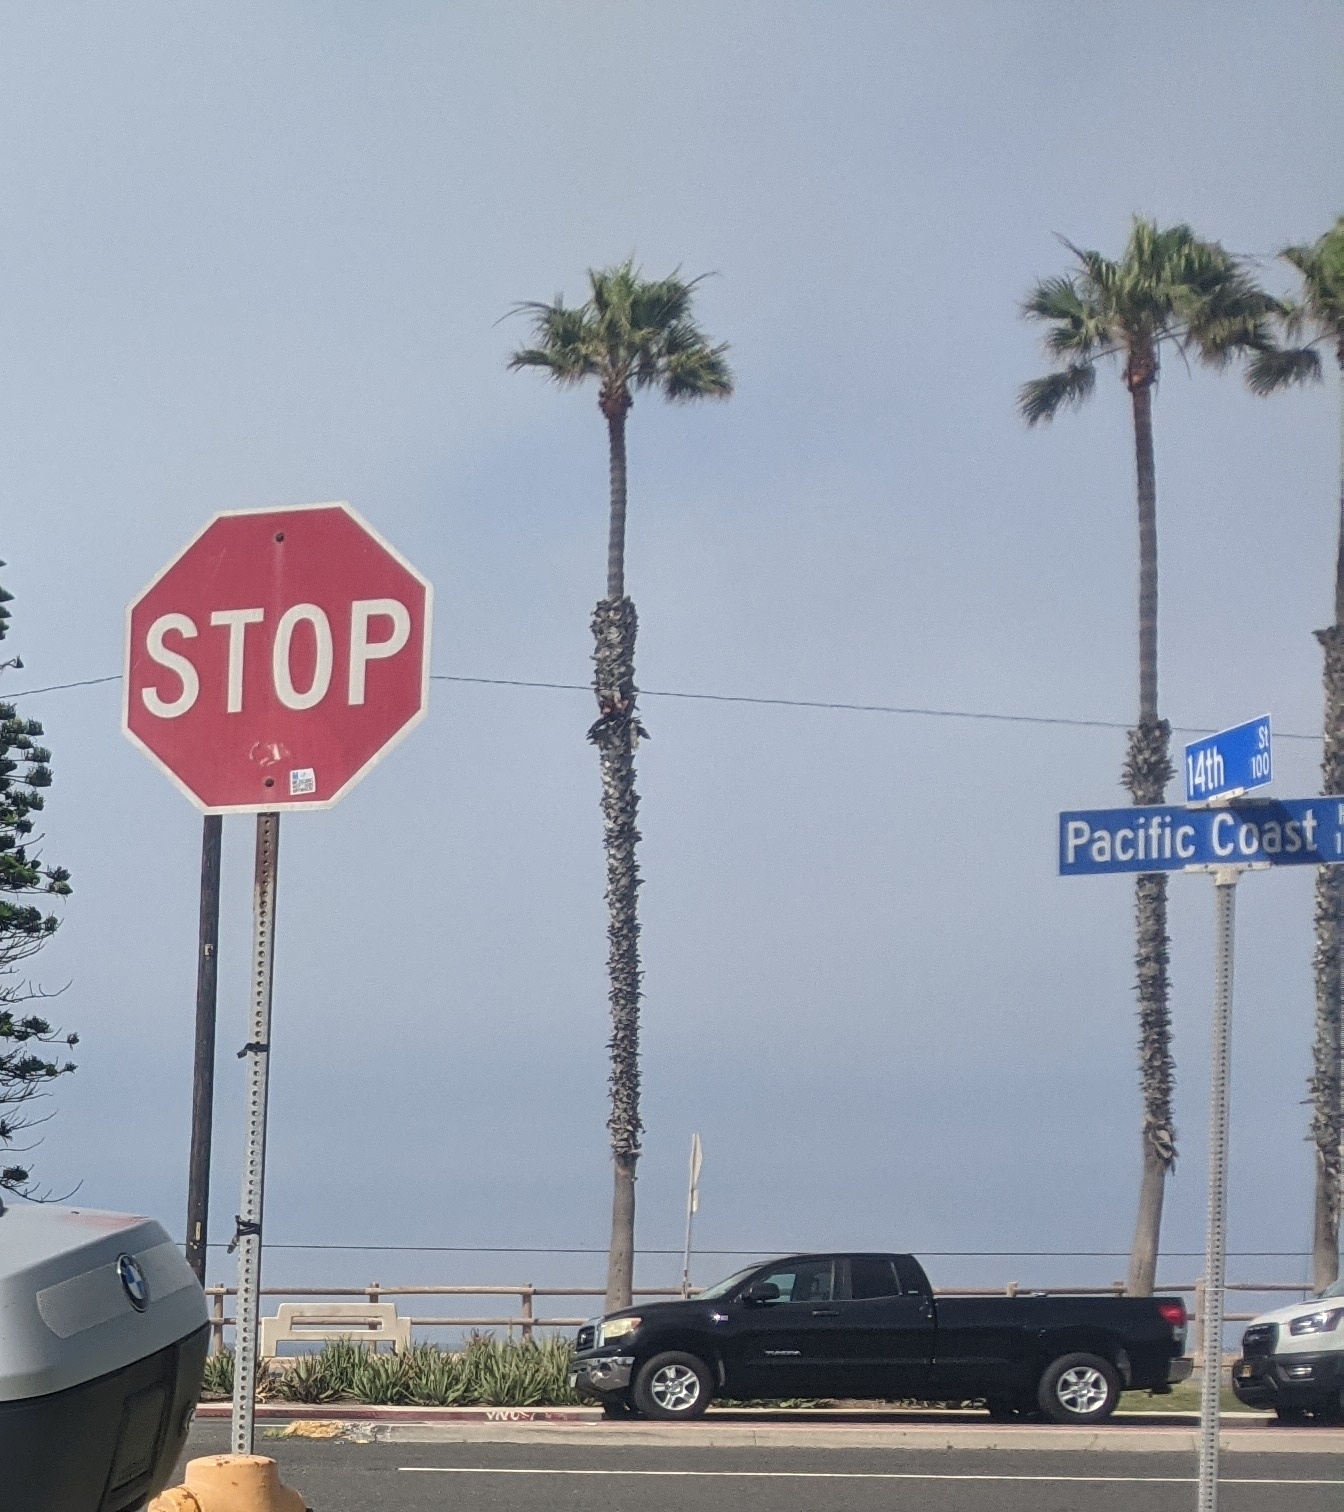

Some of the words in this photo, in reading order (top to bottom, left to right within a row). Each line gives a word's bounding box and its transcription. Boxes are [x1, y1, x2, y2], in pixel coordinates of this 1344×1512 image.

[141, 598, 412, 719] STOP
[1187, 746, 1225, 797] 14th
[1258, 725, 1269, 749] St
[1251, 752, 1269, 779] 100
[1067, 815, 1196, 864] Pacific
[1212, 809, 1318, 857] Coast
